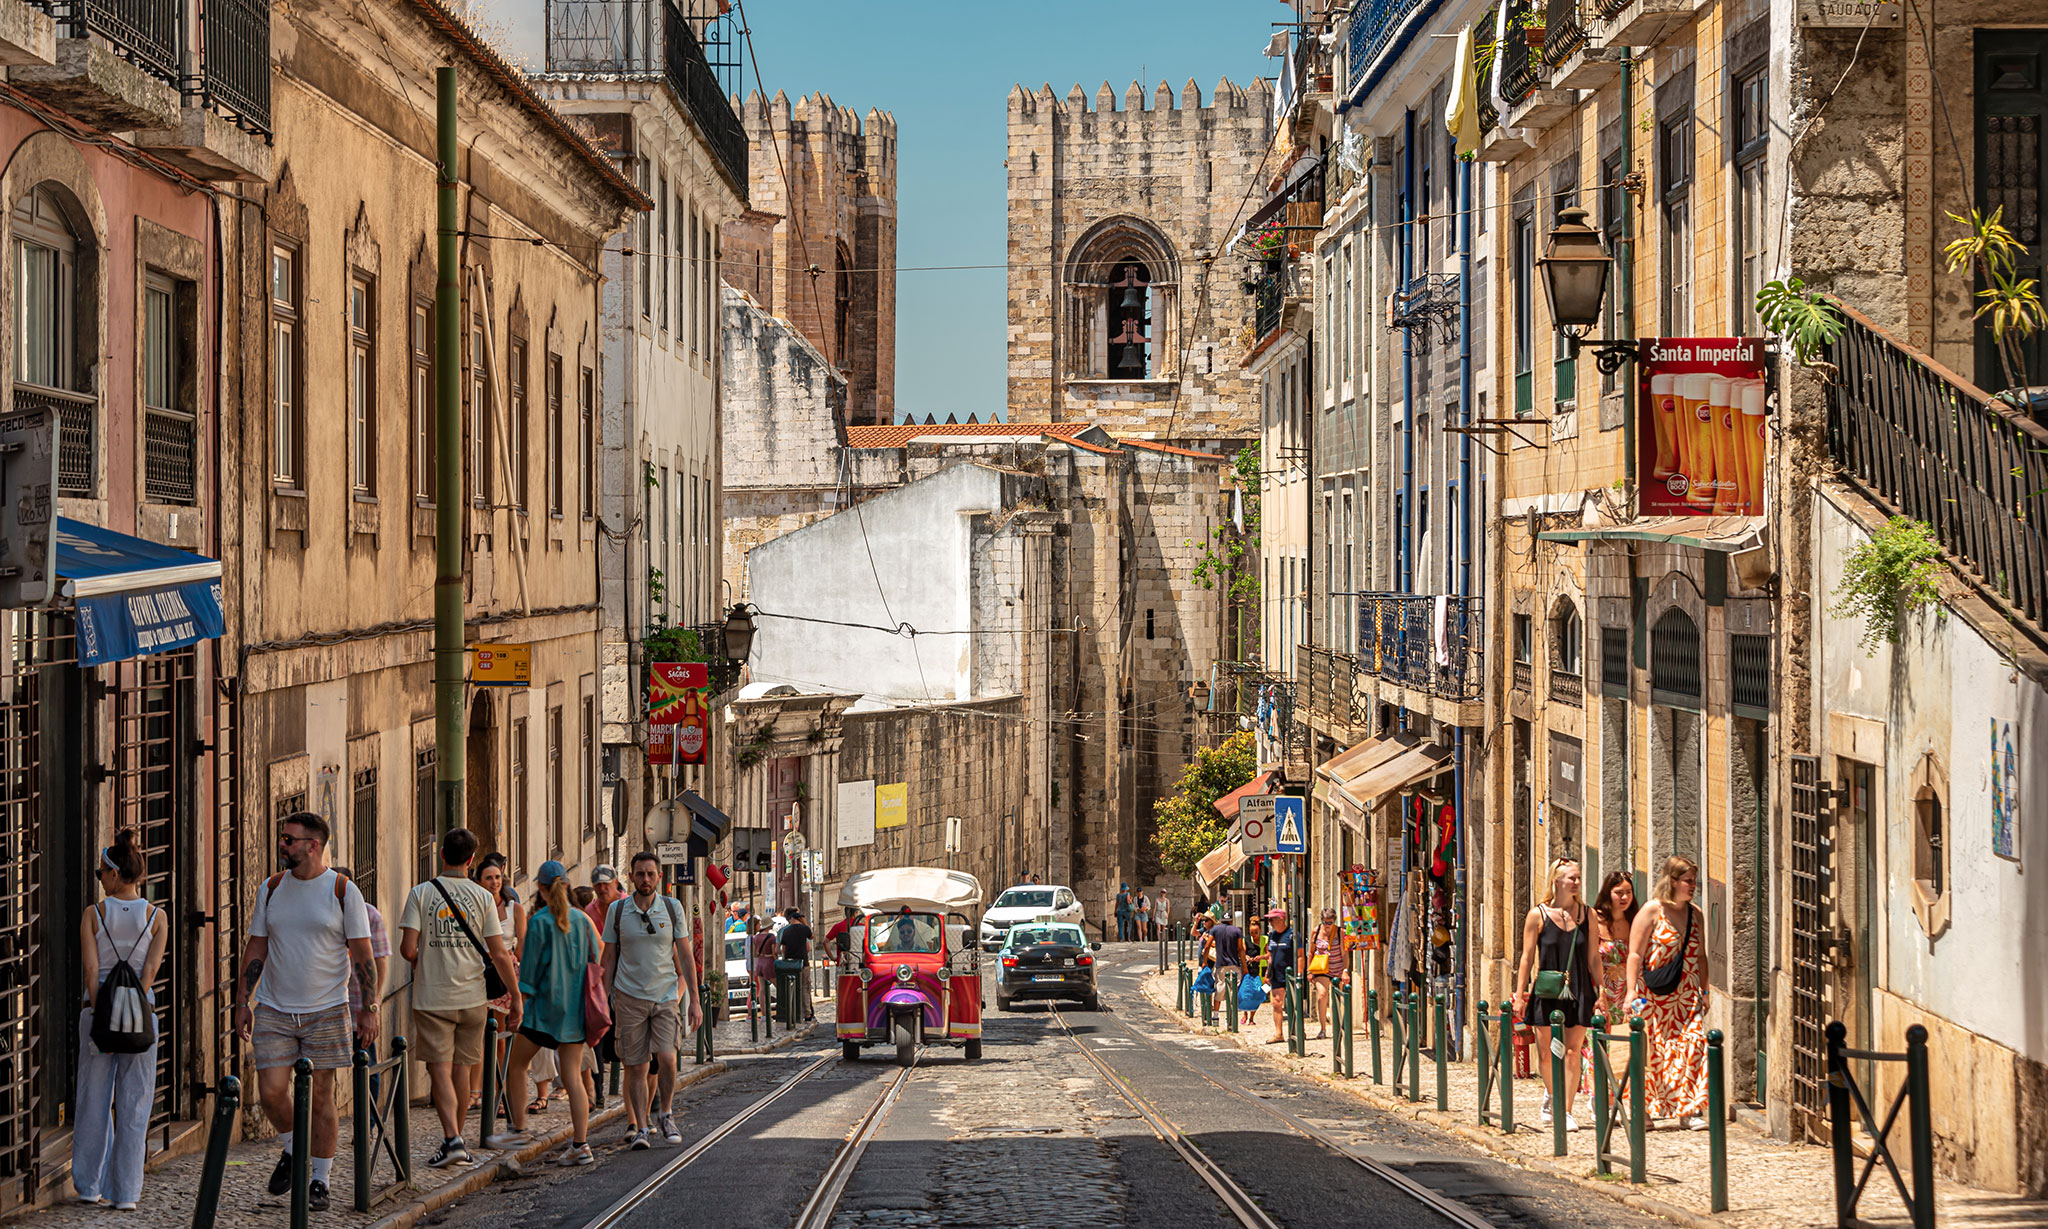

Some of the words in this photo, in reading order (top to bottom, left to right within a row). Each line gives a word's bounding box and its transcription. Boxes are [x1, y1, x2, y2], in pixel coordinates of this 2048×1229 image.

[1650, 345, 1692, 362] Santa
[1695, 344, 1754, 367] Imperial
[667, 670, 690, 679] SAGRES
[650, 723, 674, 734] MARCH
[650, 734, 664, 744] BEM
[681, 734, 703, 742] SAGRES
[650, 744, 673, 755] ALFAM
[1246, 799, 1274, 808] Alfam
